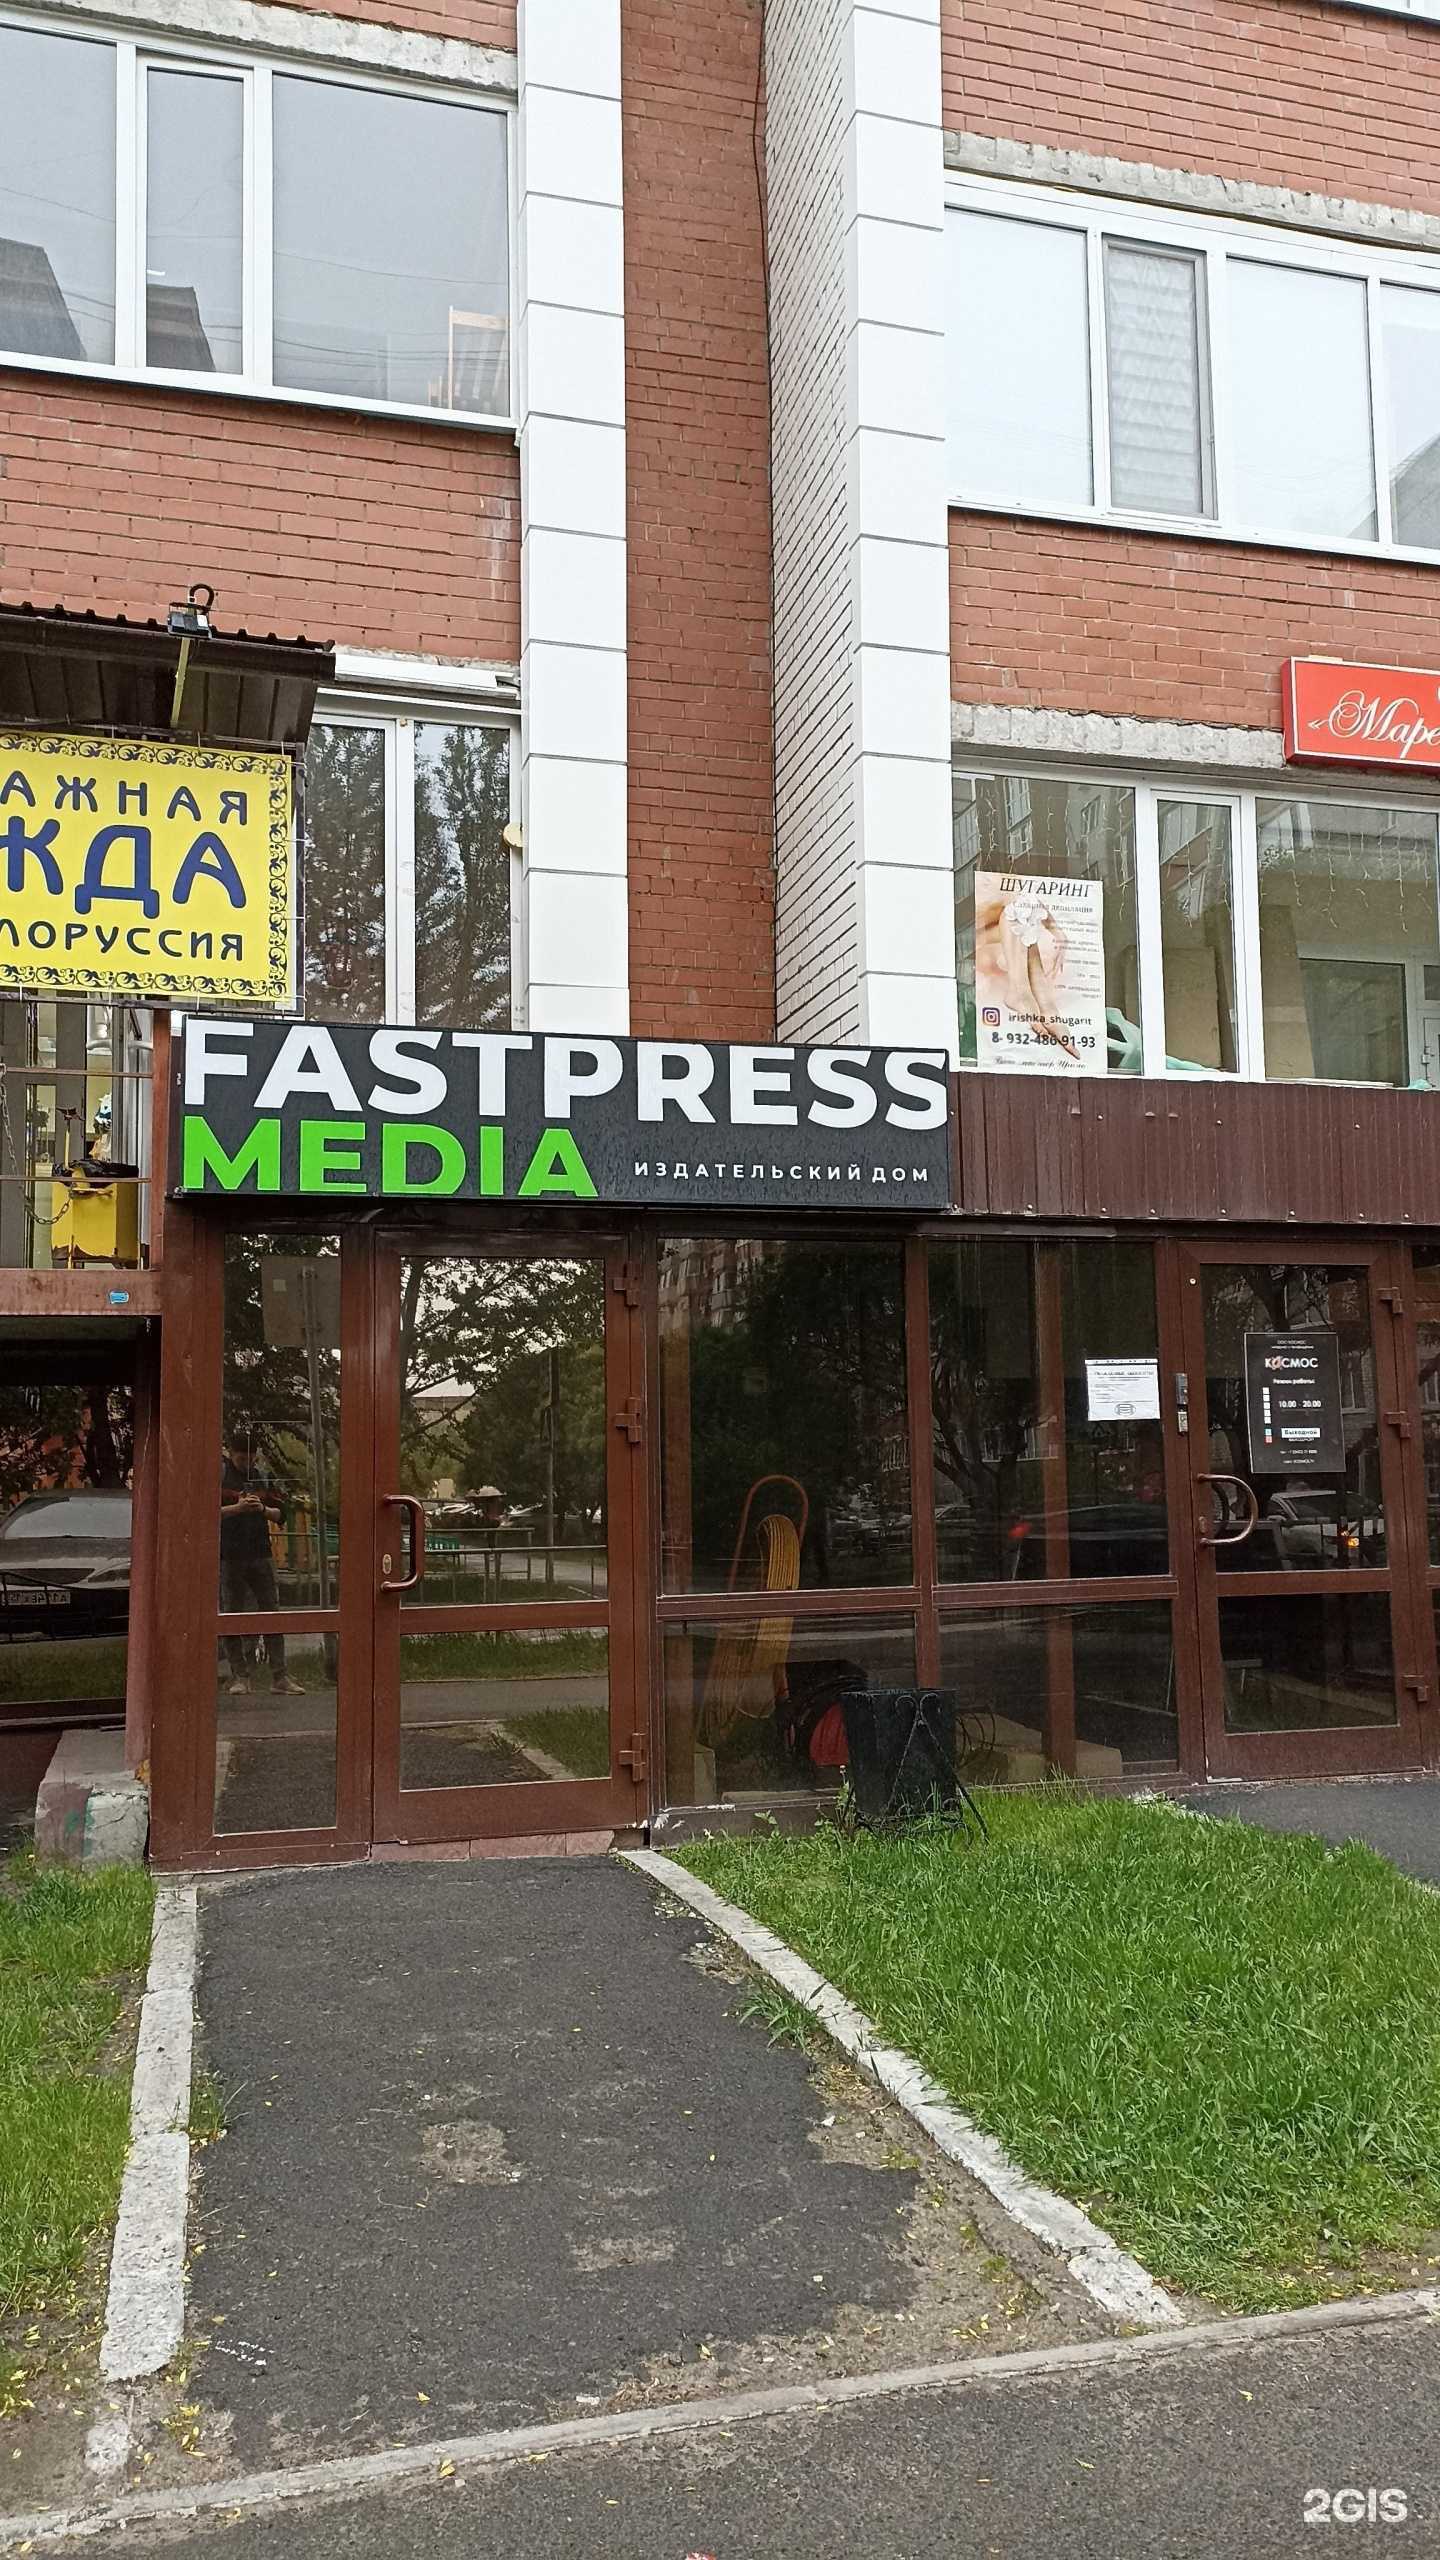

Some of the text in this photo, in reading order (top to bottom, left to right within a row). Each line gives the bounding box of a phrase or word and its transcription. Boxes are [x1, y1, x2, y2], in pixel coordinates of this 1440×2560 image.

[0, 770, 248, 826] АЖНАЯ
[1000, 877, 1093, 898] ШУГАРИНГ
[1008, 1013, 1092, 1027] irishka_shugarit
[184, 1018, 948, 1132] FASTPRESS
[183, 1115, 599, 1198] MEDIA
[634, 1161, 928, 1184] ИЗДАТЕЛЬСКИЙ ДОМ
